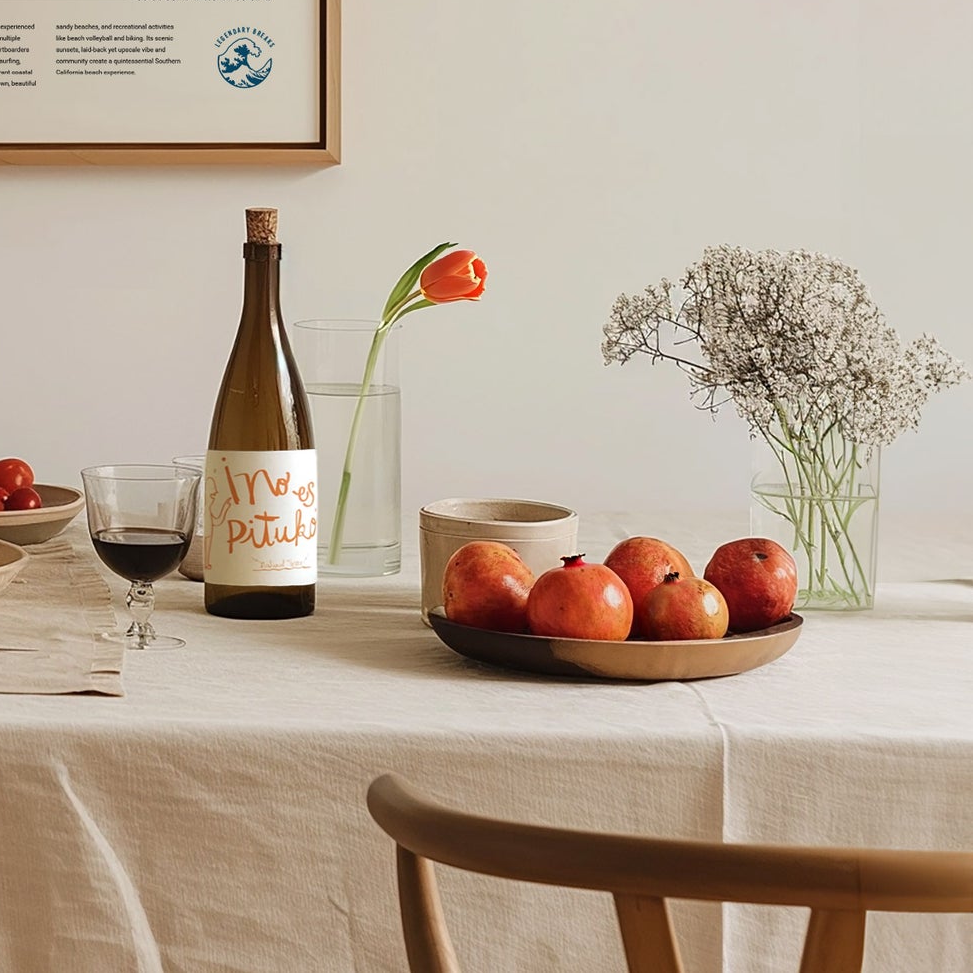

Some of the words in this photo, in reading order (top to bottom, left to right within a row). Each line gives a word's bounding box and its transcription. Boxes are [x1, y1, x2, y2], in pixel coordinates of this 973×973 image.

[0, 23, 35, 31] experienced
[55, 23, 73, 31] sandy
[86, 35, 112, 43] volleyball
[108, 46, 117, 54] yet
[118, 46, 141, 54] upscale
[55, 58, 88, 66] community
[113, 58, 154, 66] quintessential
